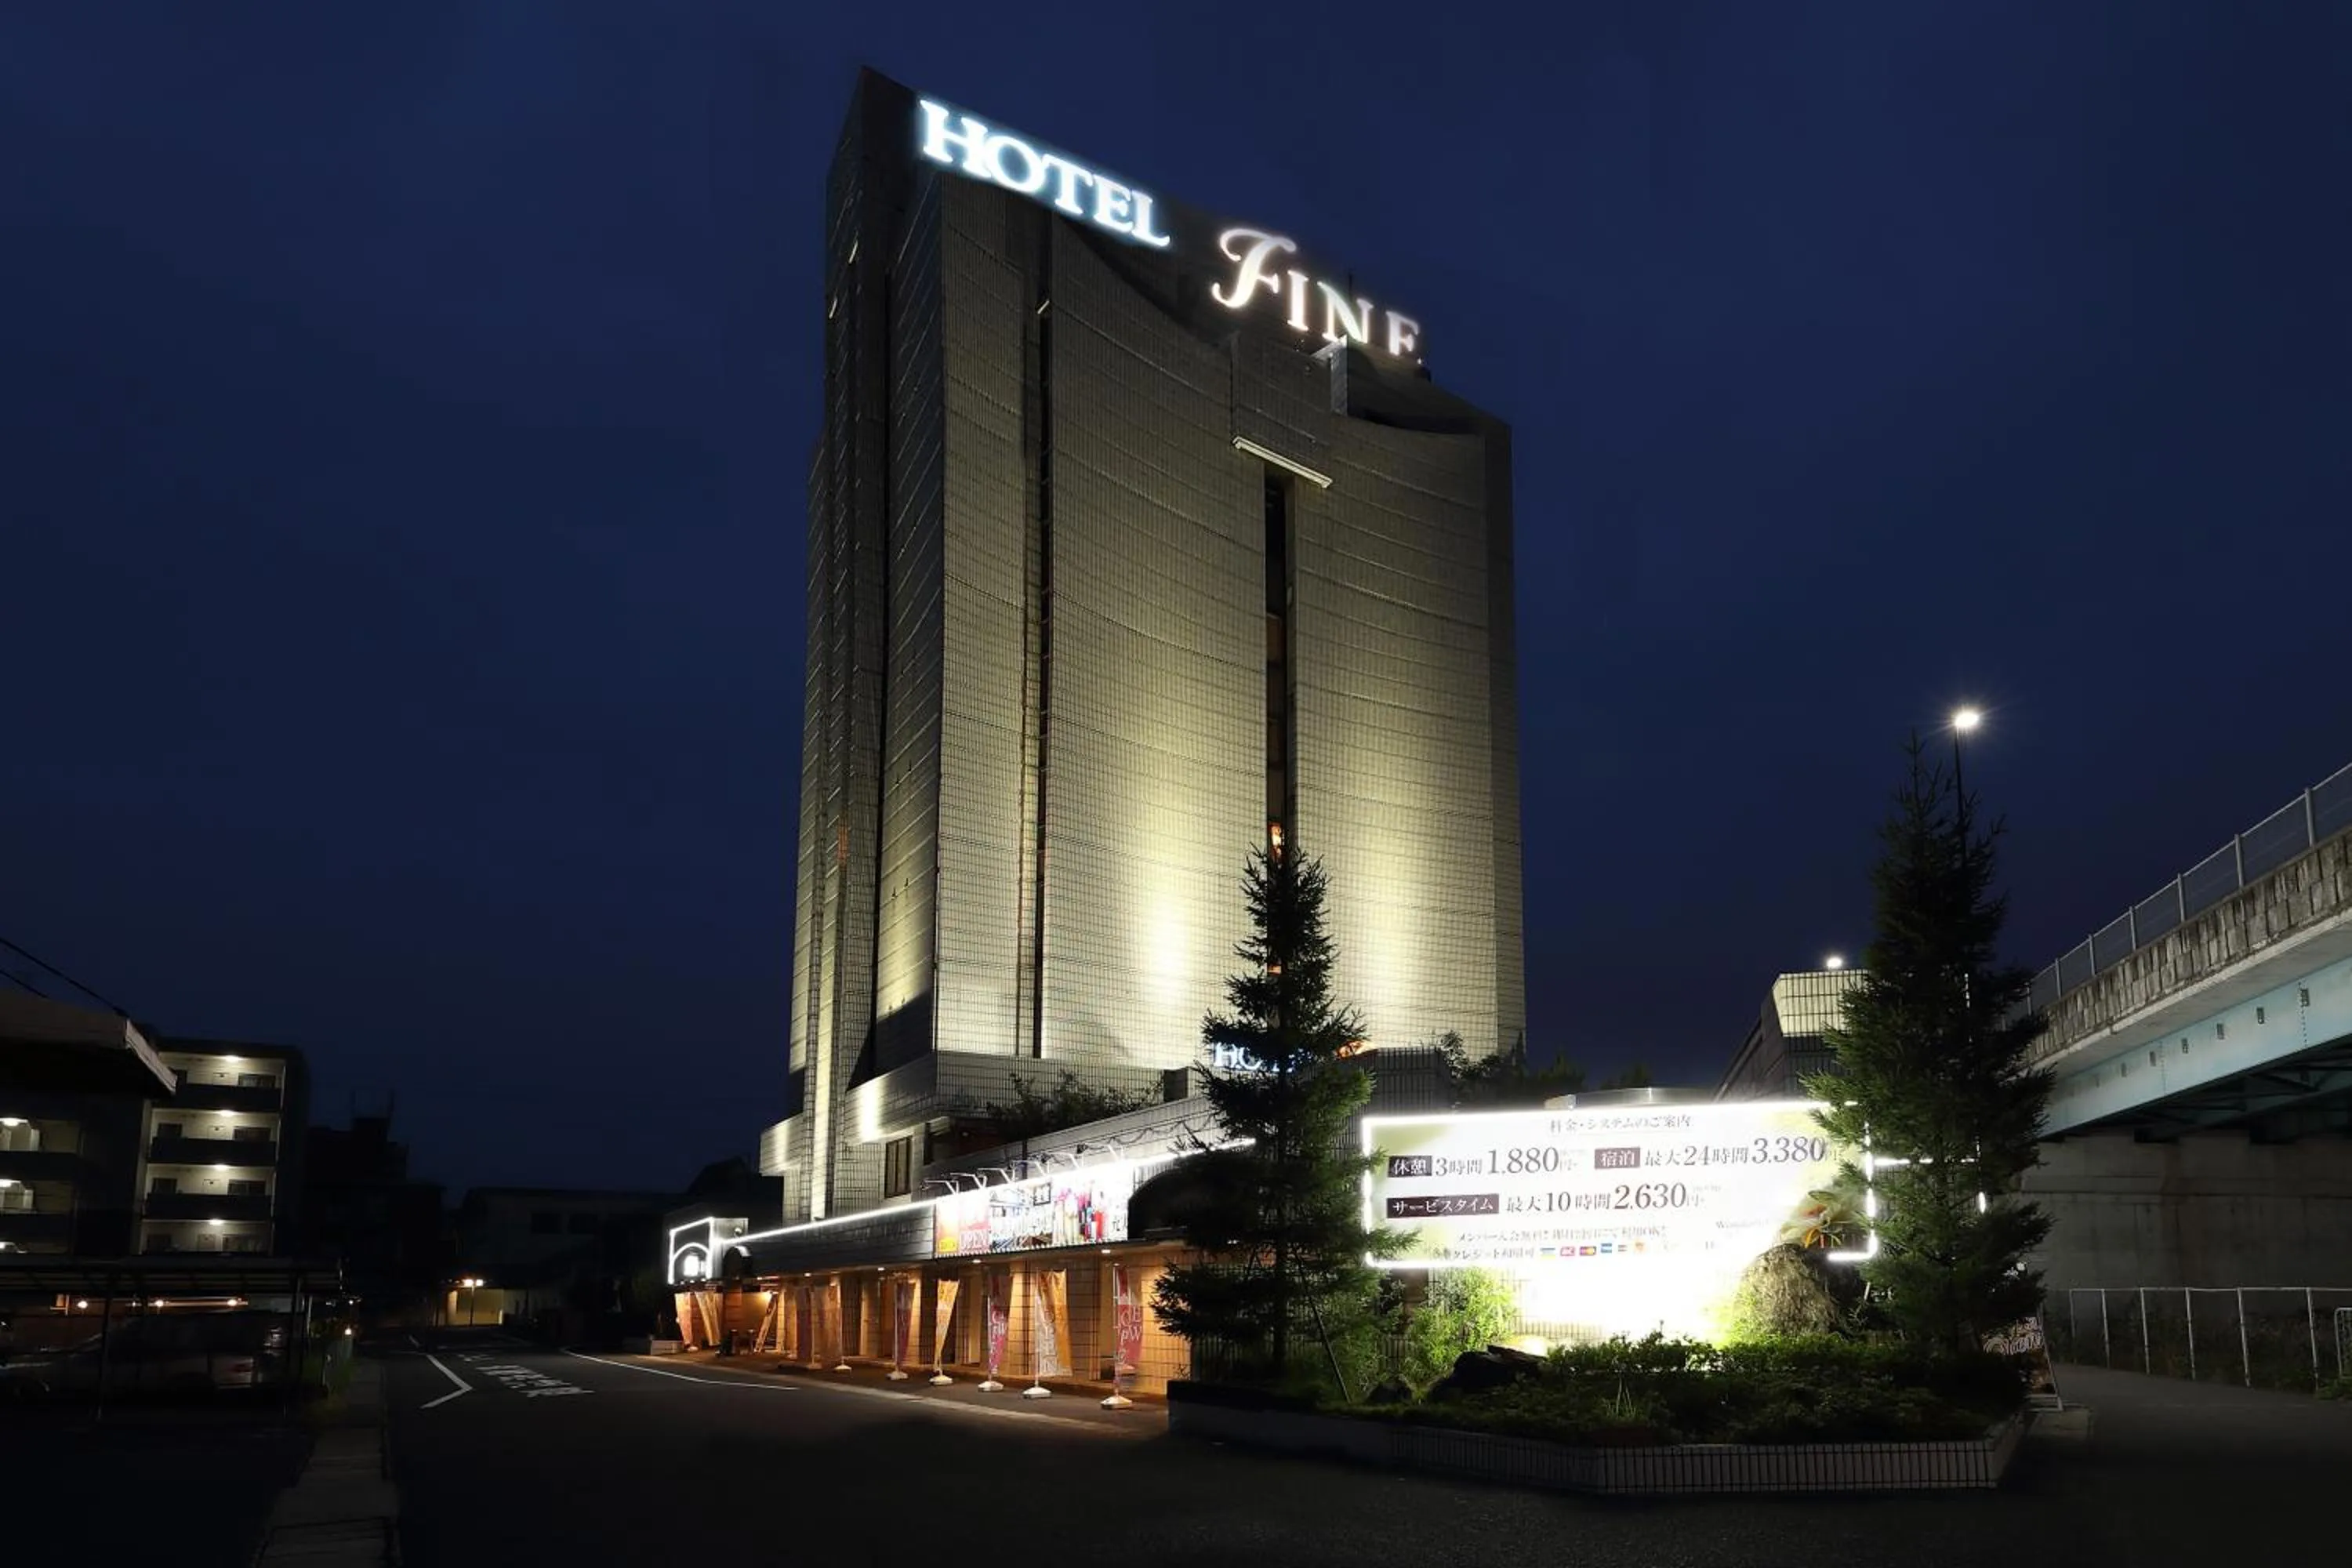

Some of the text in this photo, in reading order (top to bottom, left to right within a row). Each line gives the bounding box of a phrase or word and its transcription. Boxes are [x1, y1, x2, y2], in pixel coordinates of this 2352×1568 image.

[919, 99, 1420, 358] HOTEL FINE
[1392, 1196, 1494, 1215] サービスタイム
